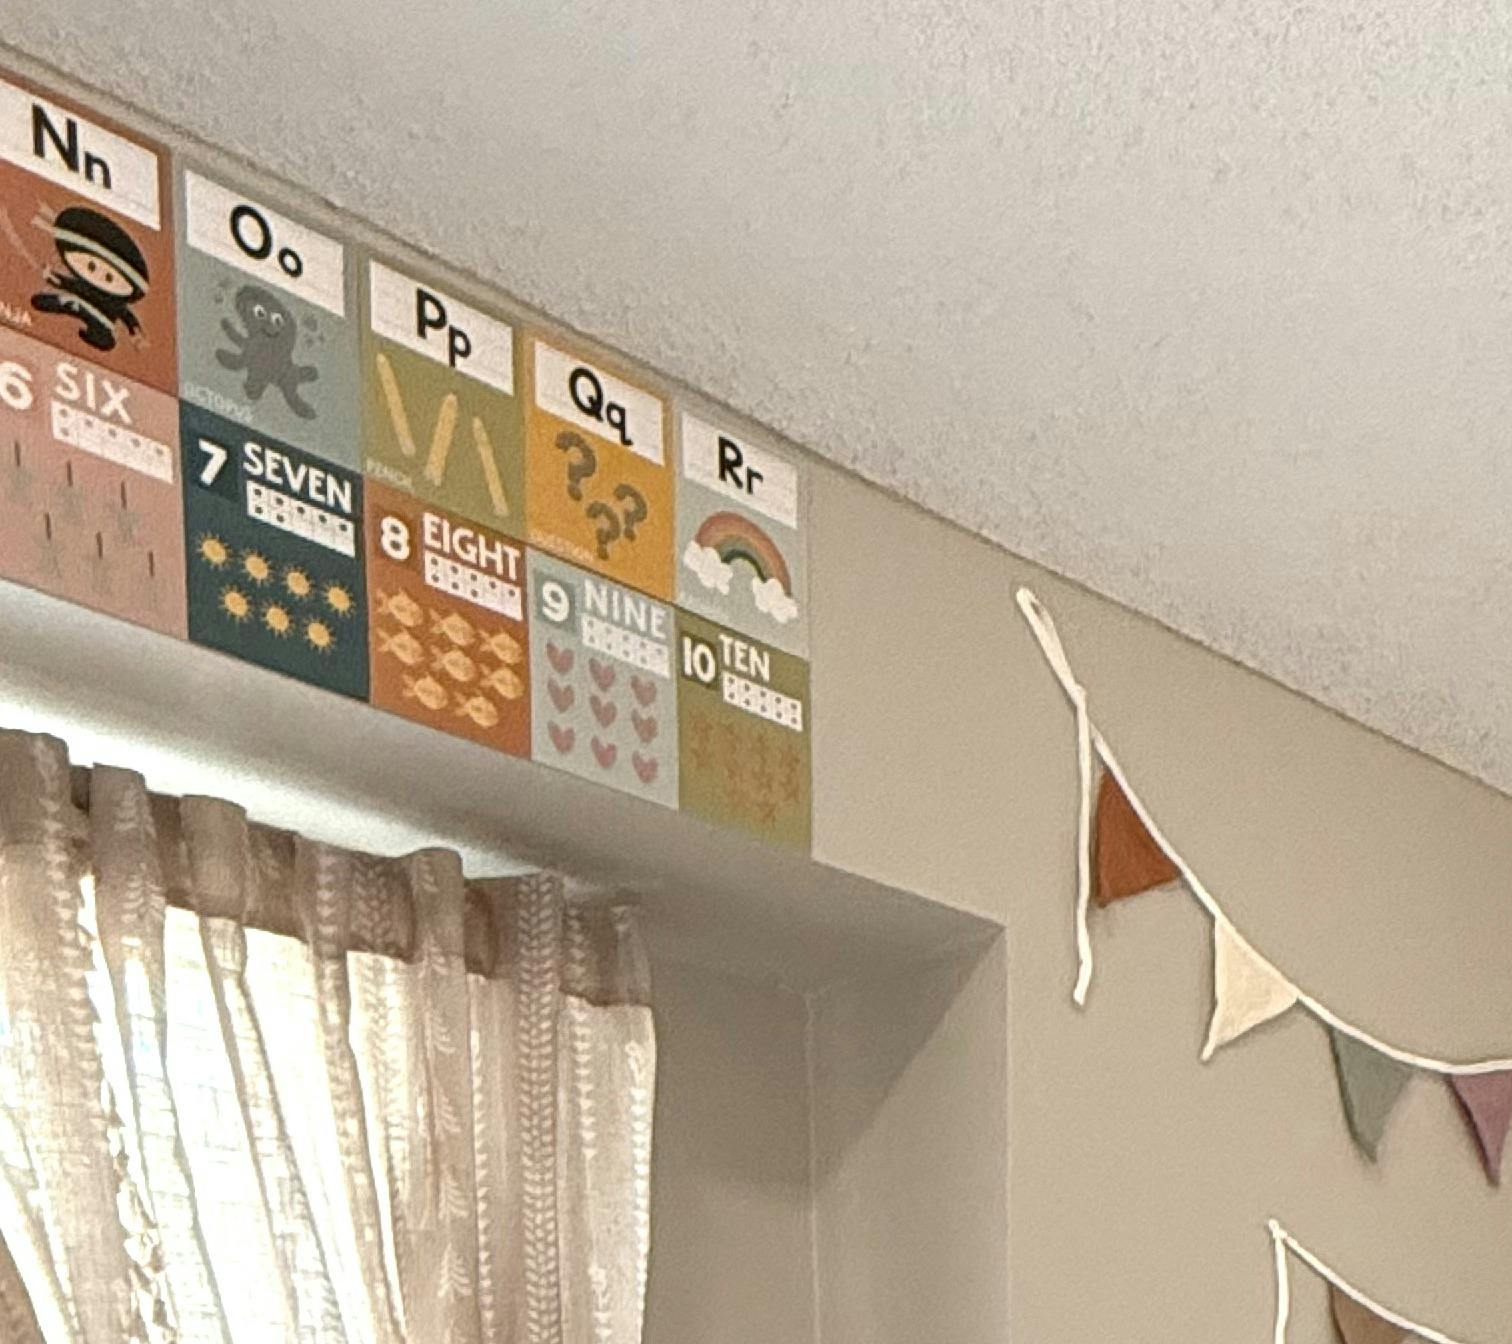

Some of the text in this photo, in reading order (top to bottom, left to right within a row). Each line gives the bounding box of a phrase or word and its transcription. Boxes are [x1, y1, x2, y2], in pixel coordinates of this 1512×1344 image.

[32, 103, 112, 189] Nn
[230, 204, 304, 279] Oo
[416, 289, 472, 367] Pp
[0, 362, 133, 425] 6 SIX
[569, 366, 633, 446] Qq
[198, 438, 229, 488] 7
[242, 440, 355, 516] SEVEN
[718, 435, 764, 496] Rr
[380, 516, 410, 561] 8
[422, 512, 522, 581] EIGHT
[541, 582, 571, 624] 9
[583, 578, 668, 641] NINE
[682, 634, 771, 684] 10 TEN
